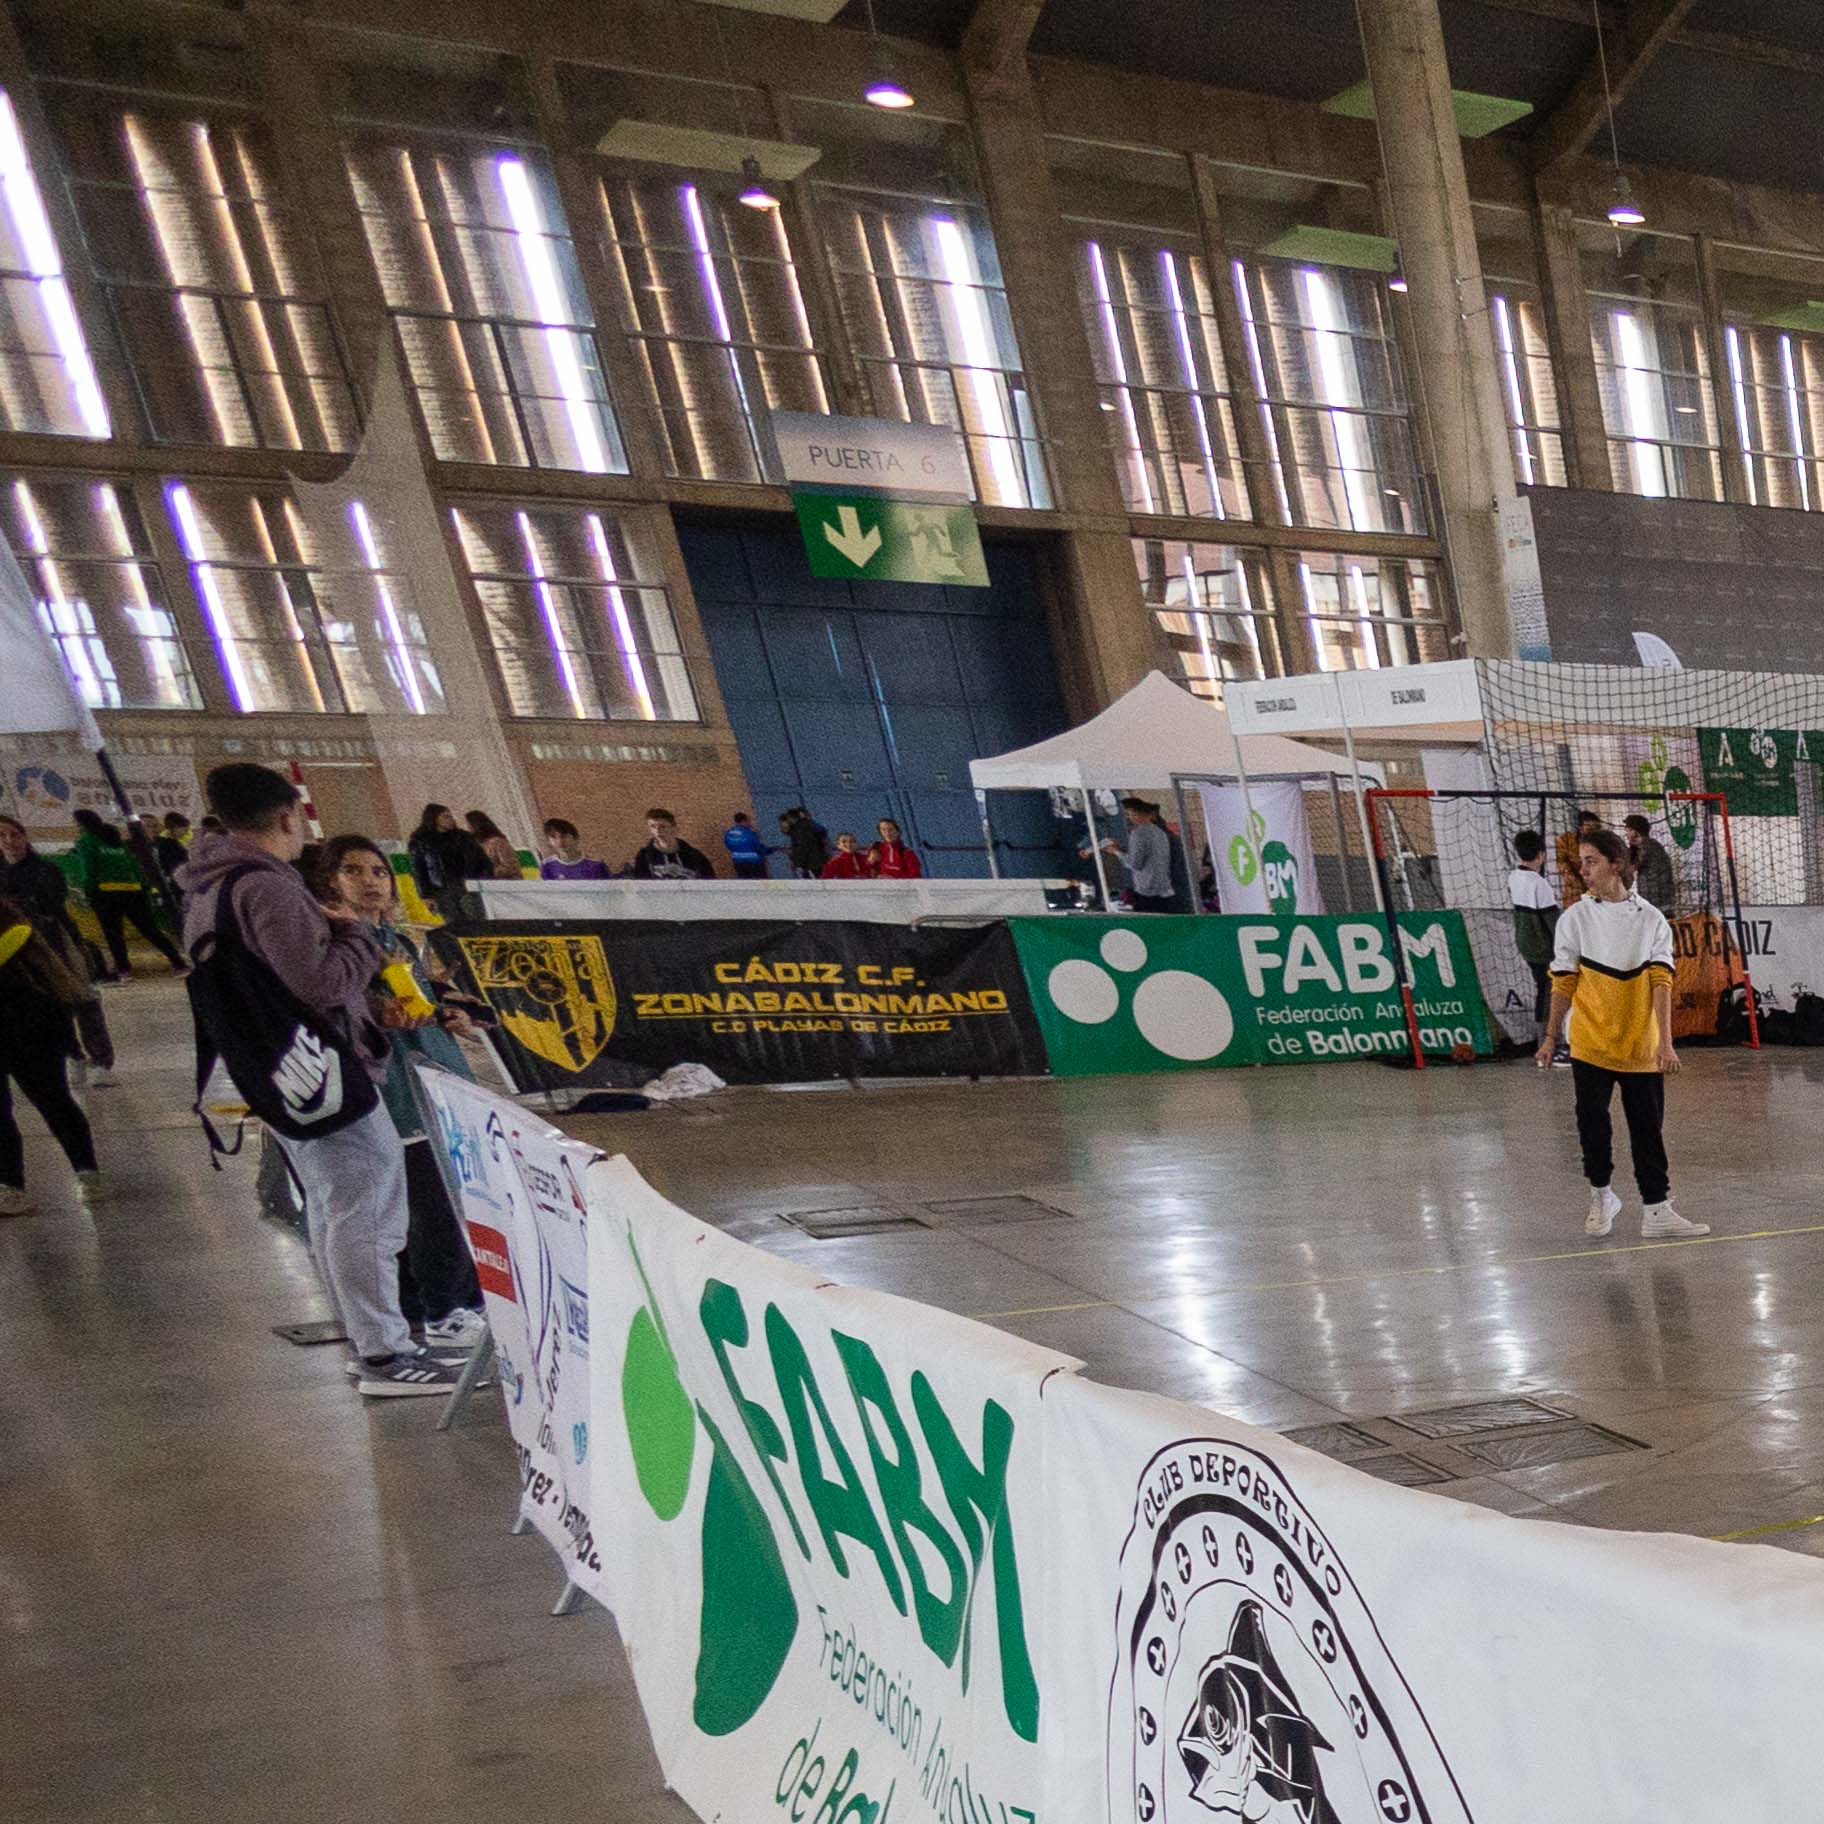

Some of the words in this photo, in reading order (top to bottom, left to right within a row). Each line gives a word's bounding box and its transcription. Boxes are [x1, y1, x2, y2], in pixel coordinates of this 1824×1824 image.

[808, 446, 905, 471] PUERTA
[921, 455, 937, 474] 6
[1238, 845, 1249, 876] F
[1264, 859, 1297, 899] BM
[714, 957, 845, 985] CÁDIZ
[857, 965, 926, 988] C.F.
[1237, 923, 1456, 997] FABM
[633, 990, 1009, 1016] ZONABALONMANO
[1256, 1004, 1364, 1026] Federación
[1375, 999, 1465, 1020] Analuza
[752, 1019, 843, 1034] PLAYAS
[851, 1020, 879, 1034] DE
[884, 1016, 951, 1035] CÁDIZ
[1267, 1033, 1301, 1056] de
[272, 1024, 325, 1110] NIKE
[699, 1278, 1040, 1744] FABM
[1143, 1461, 1184, 1530] CLUB
[1188, 1452, 1342, 1596] DEPORTIVO
[816, 1604, 924, 1768] Federación
[775, 1717, 825, 1824] de
